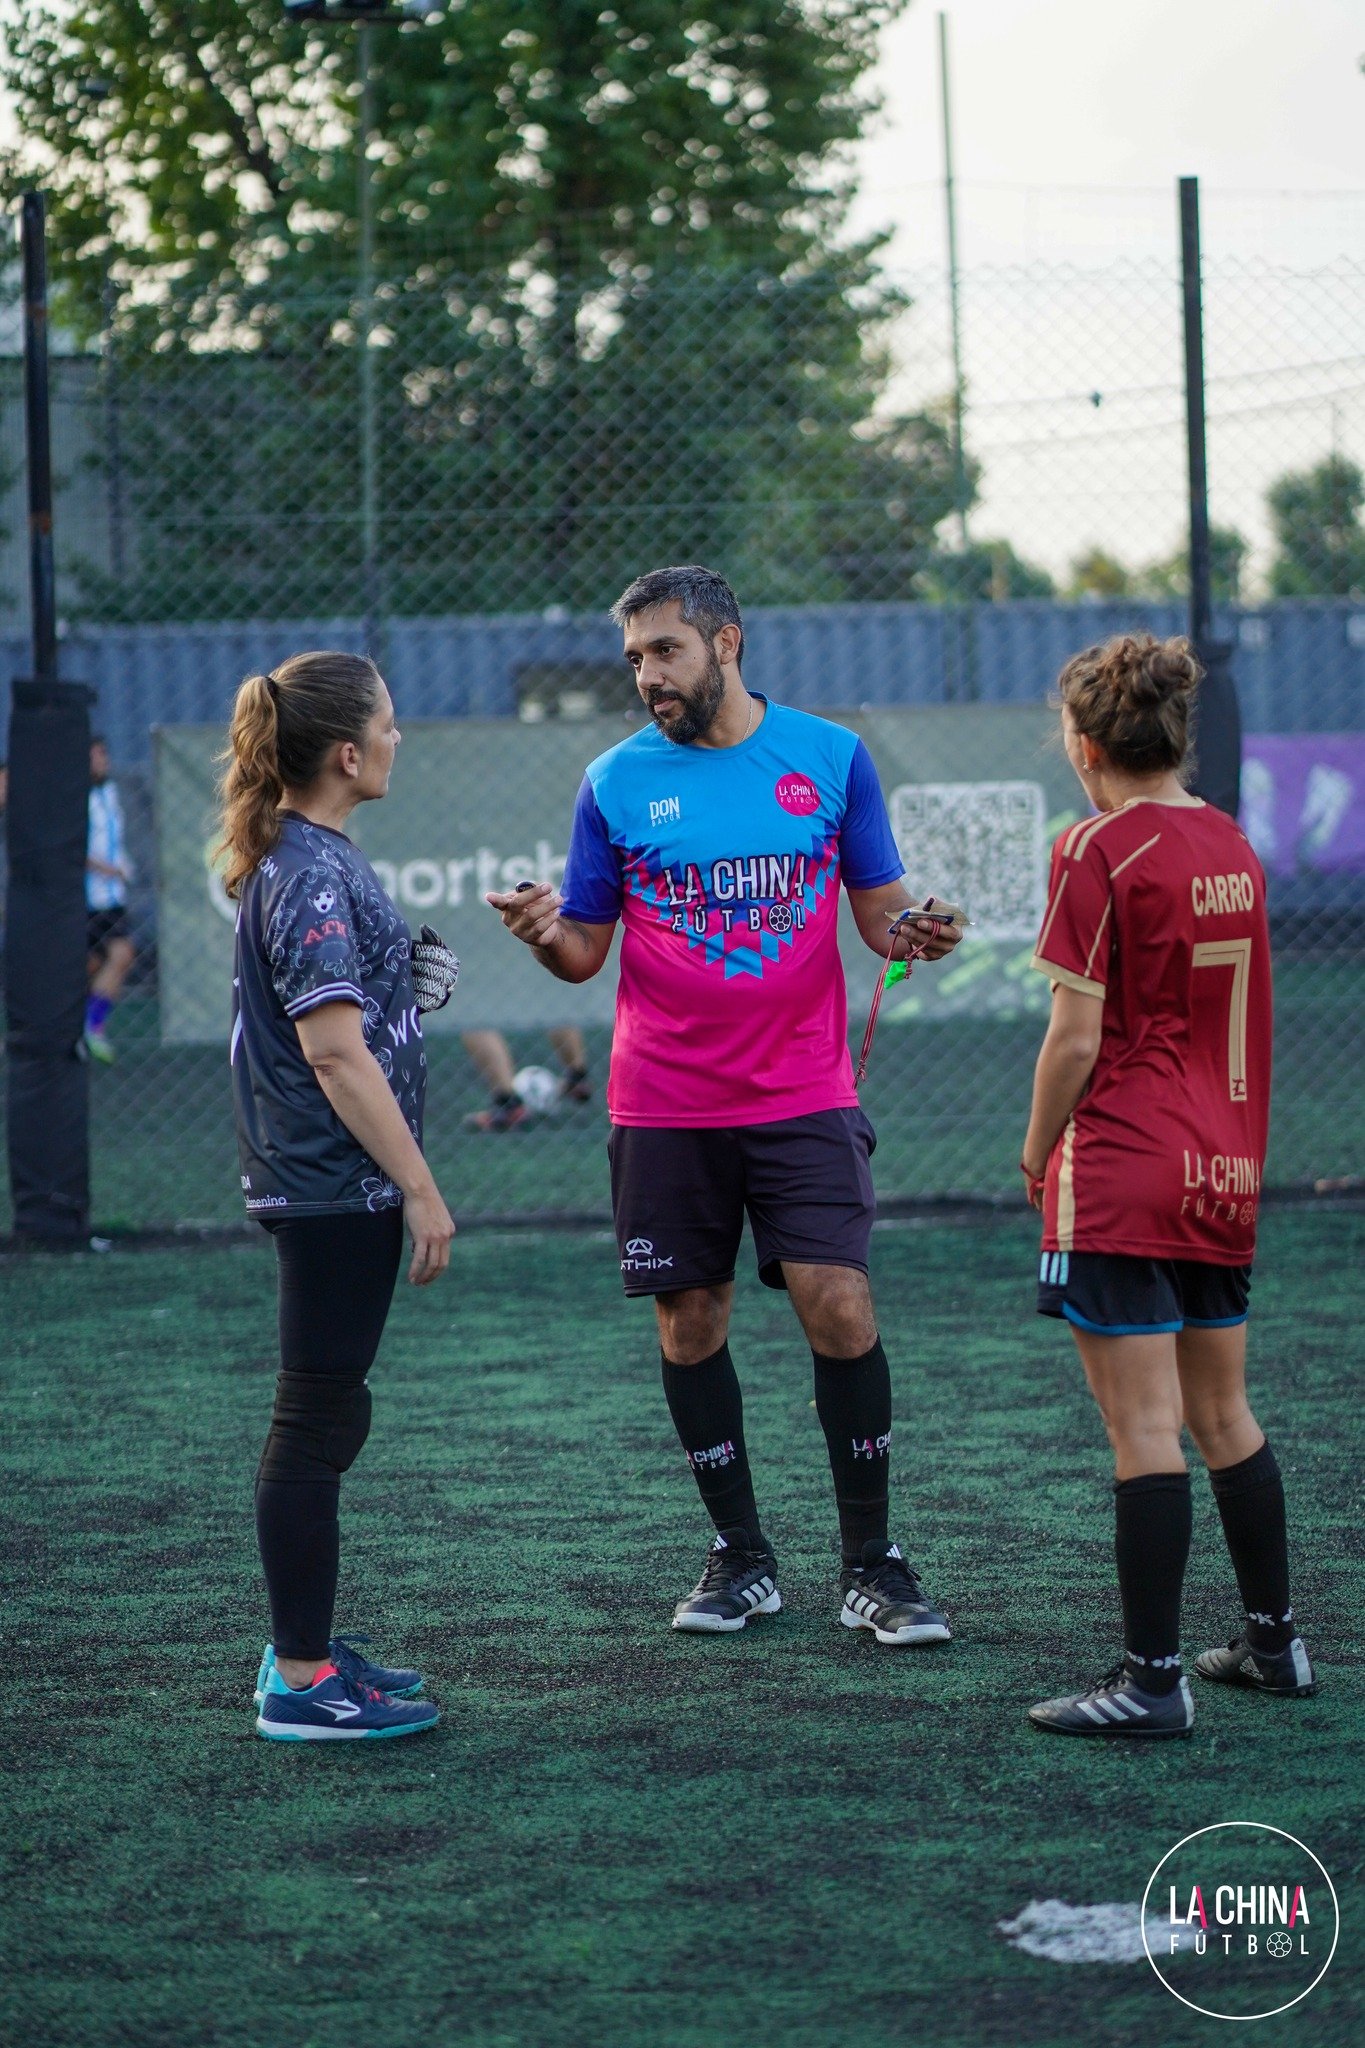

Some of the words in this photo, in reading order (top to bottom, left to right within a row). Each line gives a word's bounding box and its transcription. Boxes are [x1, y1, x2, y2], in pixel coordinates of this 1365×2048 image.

[649, 796, 680, 820] DON
[664, 865, 706, 906] LA
[712, 856, 805, 902] CHINA
[1191, 872, 1254, 917] CARRO
[416, 949, 457, 964] umbro
[1192, 937, 1252, 1102] 7
[1183, 1149, 1207, 1190] LA
[694, 1440, 734, 1463] CHINA
[852, 1438, 873, 1453] LA
